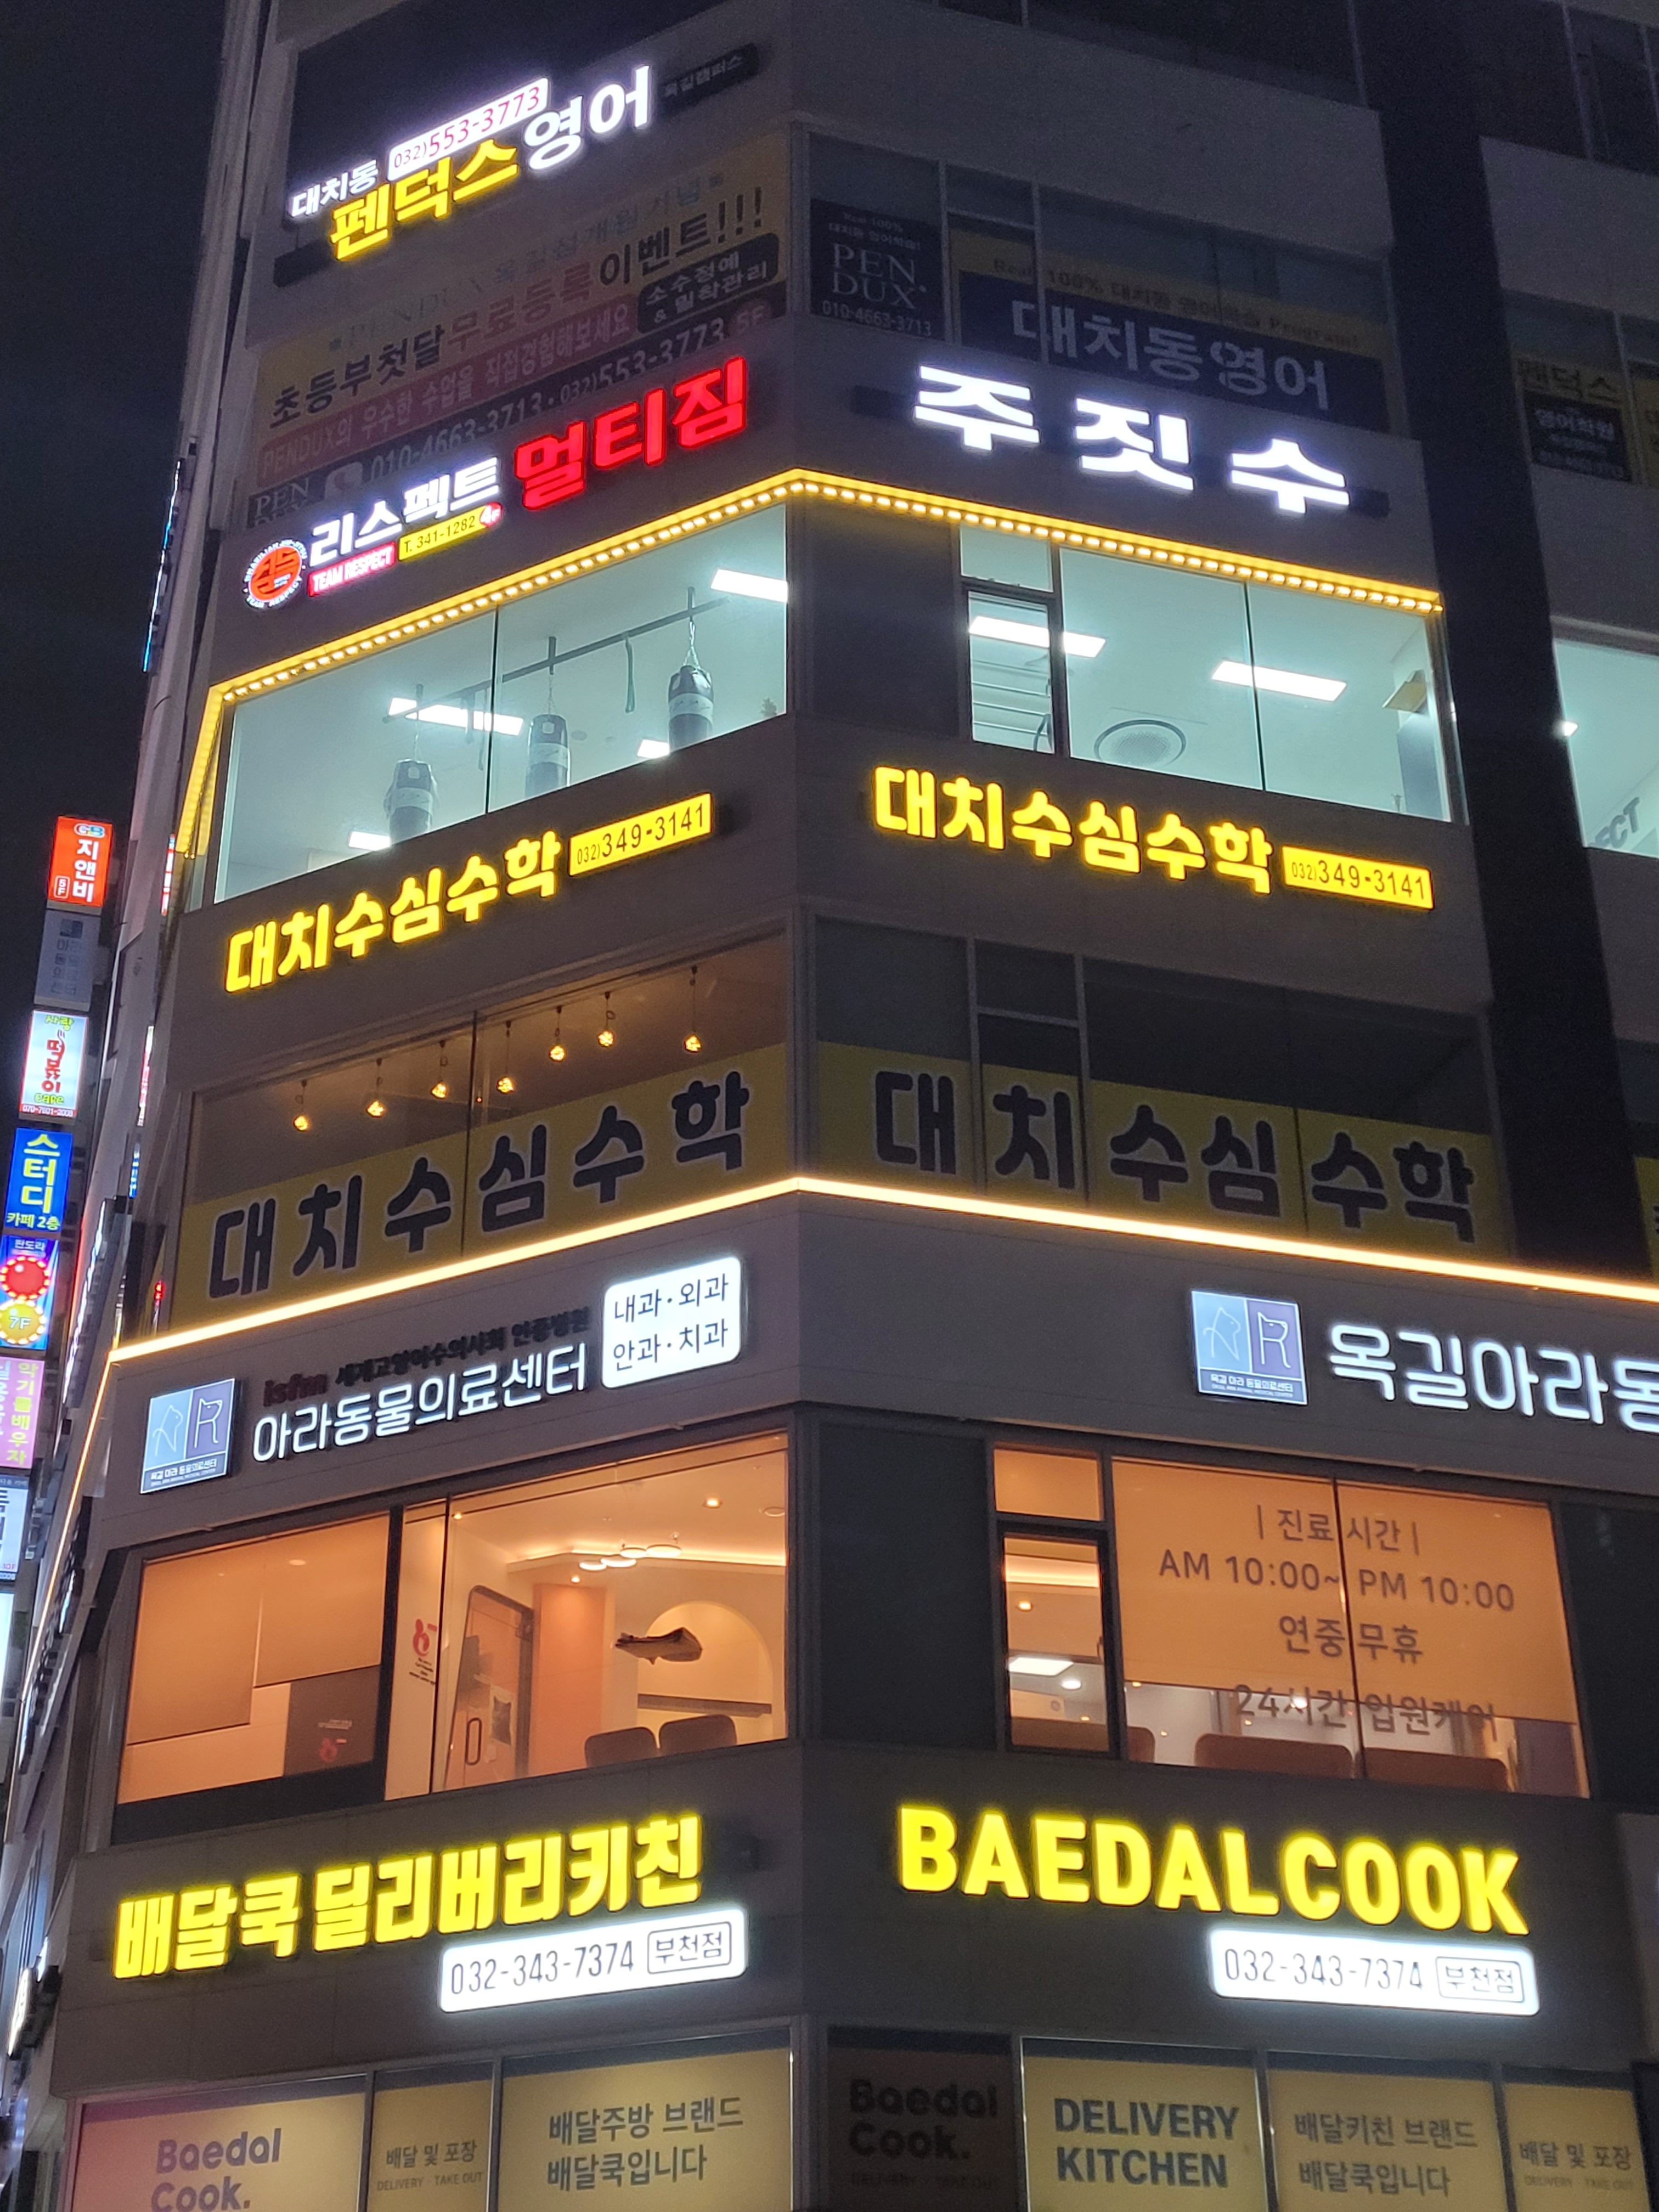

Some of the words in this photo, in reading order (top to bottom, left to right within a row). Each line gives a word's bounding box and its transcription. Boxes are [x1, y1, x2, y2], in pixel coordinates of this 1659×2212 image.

[393, 84, 541, 170] 032)553-3773
[291, 160, 379, 217] 대치동
[646, 252, 740, 306] 소수정예
[831, 243, 916, 284] PEN
[832, 272, 917, 309] DUX
[362, 389, 413, 440] 우수한
[515, 356, 746, 510] 멀티짐
[913, 365, 1350, 514] 주짓수
[255, 477, 309, 517] PEN
[309, 456, 499, 567] 리스펙트
[416, 516, 476, 549] 341-1282
[313, 567, 343, 593] TEAM
[345, 548, 393, 580] RESPECT
[874, 765, 1273, 894] 대치수심수학
[1290, 860, 1427, 902] 032)349-3141
[72, 839, 99, 902] 지앤비
[225, 830, 561, 994] 대치수심수학
[577, 806, 704, 867] 032)349-3141
[21, 1133, 60, 1214] 스터디
[875, 1069, 1475, 1244] 대치수심수학
[208, 1070, 750, 1299] 대치수심수학
[7, 1212, 35, 1228] 카페
[37, 1216, 60, 1231] 2층
[9, 1317, 31, 1329] 7F
[253, 1342, 586, 1462] 아라동물의료센터
[1278, 1508, 1335, 1543] 진료
[1347, 1516, 1401, 1553] 시간
[1159, 1549, 1210, 1580] AM
[1358, 1568, 1407, 1600] PM
[1421, 1575, 1515, 1611] 10:00
[114, 1872, 300, 1979] 배달쿡
[312, 1814, 703, 1953] 딜리버리키친
[450, 1940, 634, 1996] 032-343-7374
[654, 1928, 724, 1967] 부천점
[1223, 1948, 1424, 1991] 032-343-7374
[1445, 1966, 1517, 1995] 부천점
[548, 2101, 653, 2146] 배달주방
[662, 2095, 744, 2134] 브랜드
[1054, 2097, 1239, 2140] DELIVERY
[1295, 2112, 1395, 2147] 배달키친
[1404, 2118, 1479, 2149] 브랜드
[156, 2128, 281, 2174] Baedal
[386, 2145, 418, 2169] 배달
[424, 2143, 438, 2166] 및
[444, 2140, 477, 2163] 포장
[546, 2144, 708, 2193] 배달쿡입니다
[1055, 2146, 1229, 2190] KITCHEN
[1520, 2141, 1559, 2167] 배달
[1594, 2146, 1630, 2170] 포장
[377, 2176, 424, 2192] DELIVERY
[1298, 2159, 1452, 2199] 배달쿡입니다
